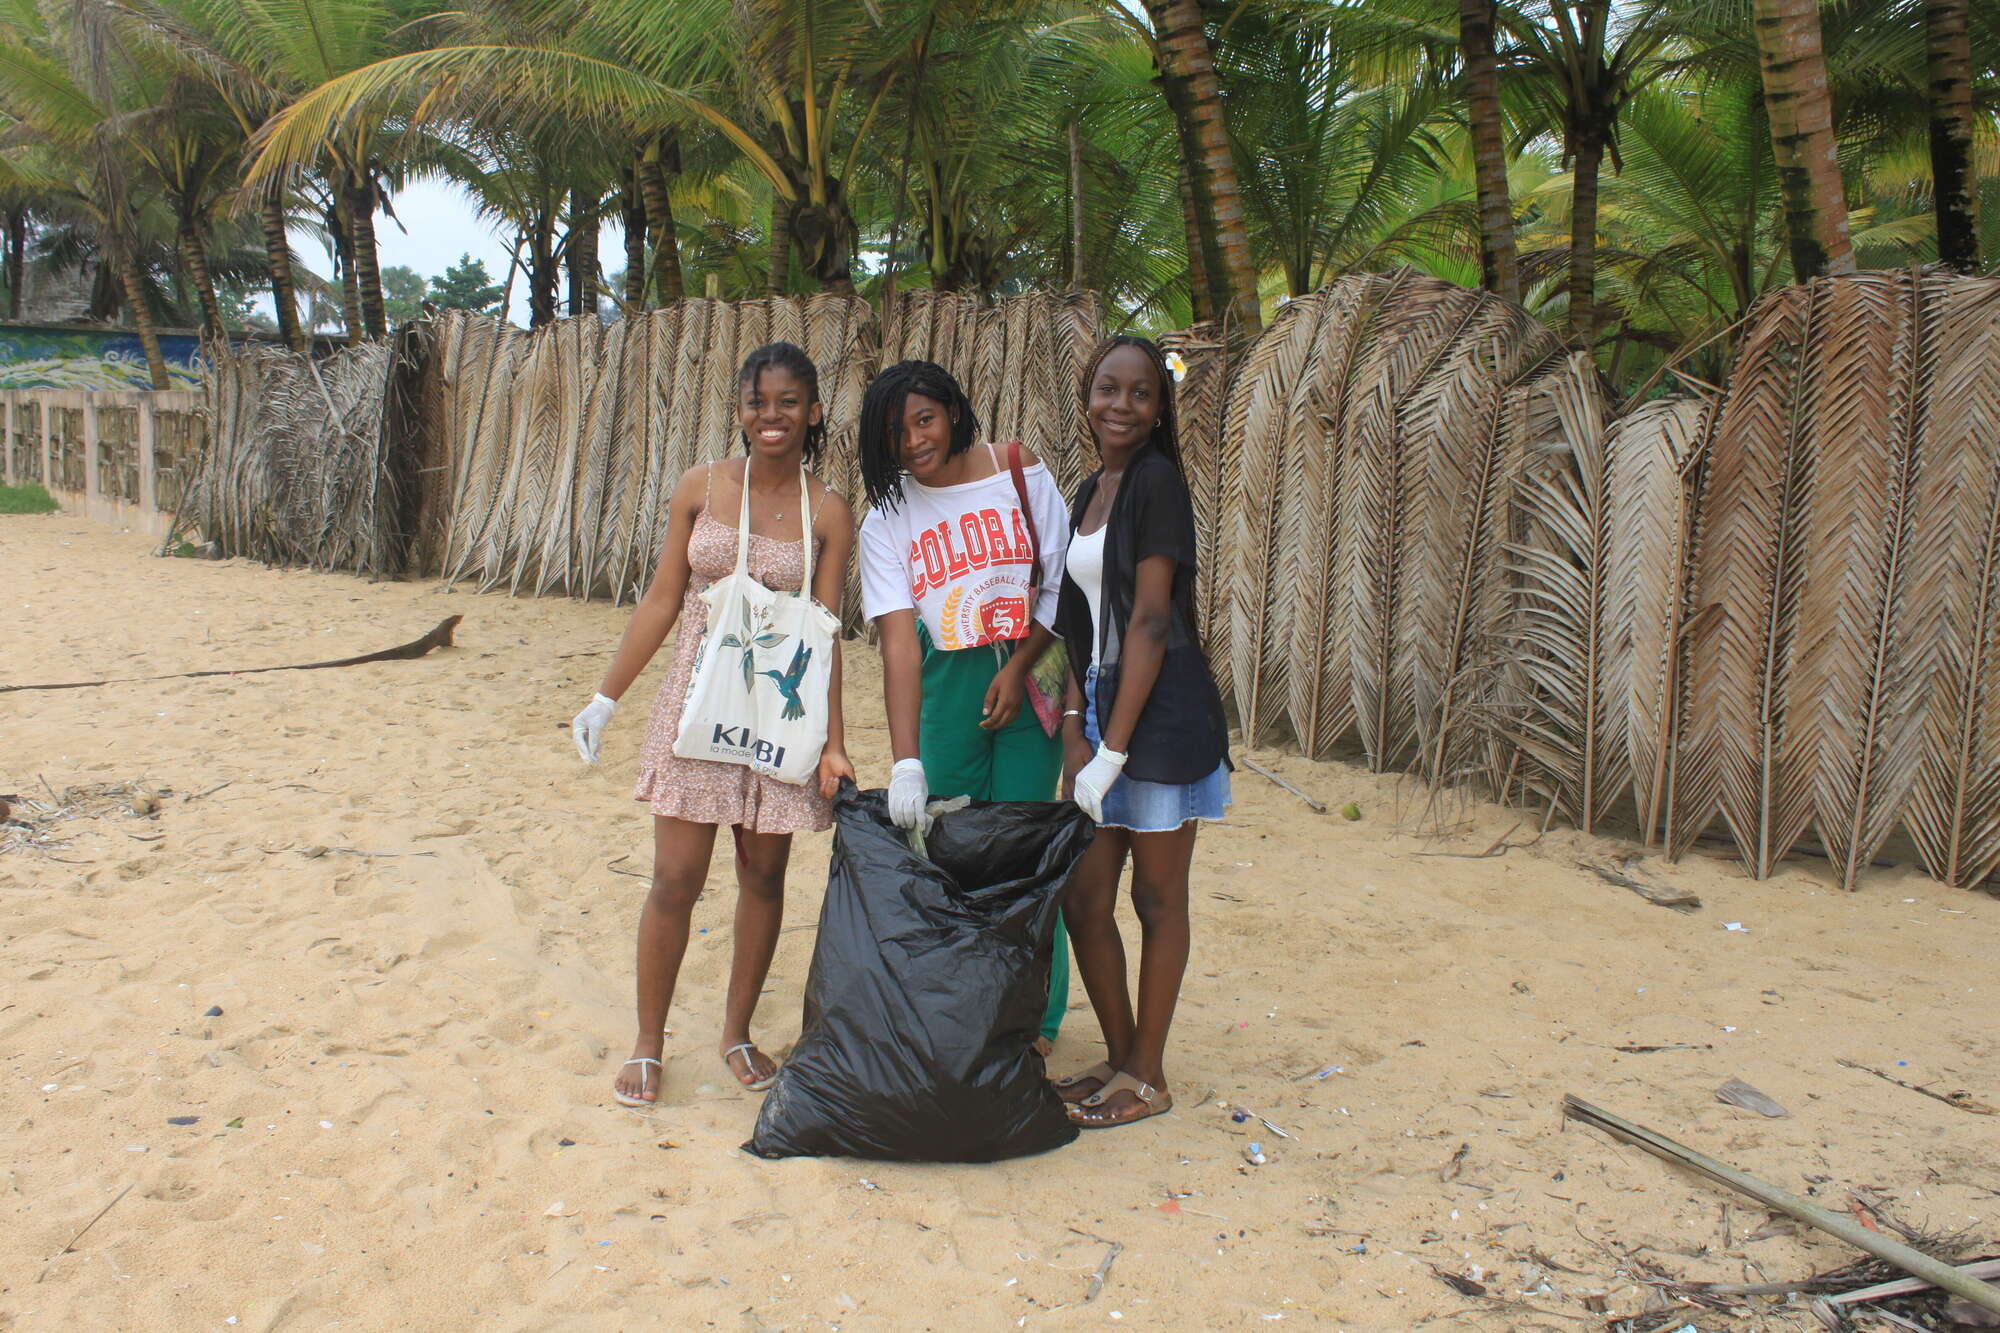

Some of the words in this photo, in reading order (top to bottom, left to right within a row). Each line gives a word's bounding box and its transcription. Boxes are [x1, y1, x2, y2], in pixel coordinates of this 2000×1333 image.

[911, 506, 1034, 601] COLORA
[961, 595, 976, 641] UNIVERSITY
[974, 575, 1016, 595] BASEBALL
[709, 744, 719, 753] la
[721, 746, 751, 758] mode
[711, 723, 786, 768] KIBI
